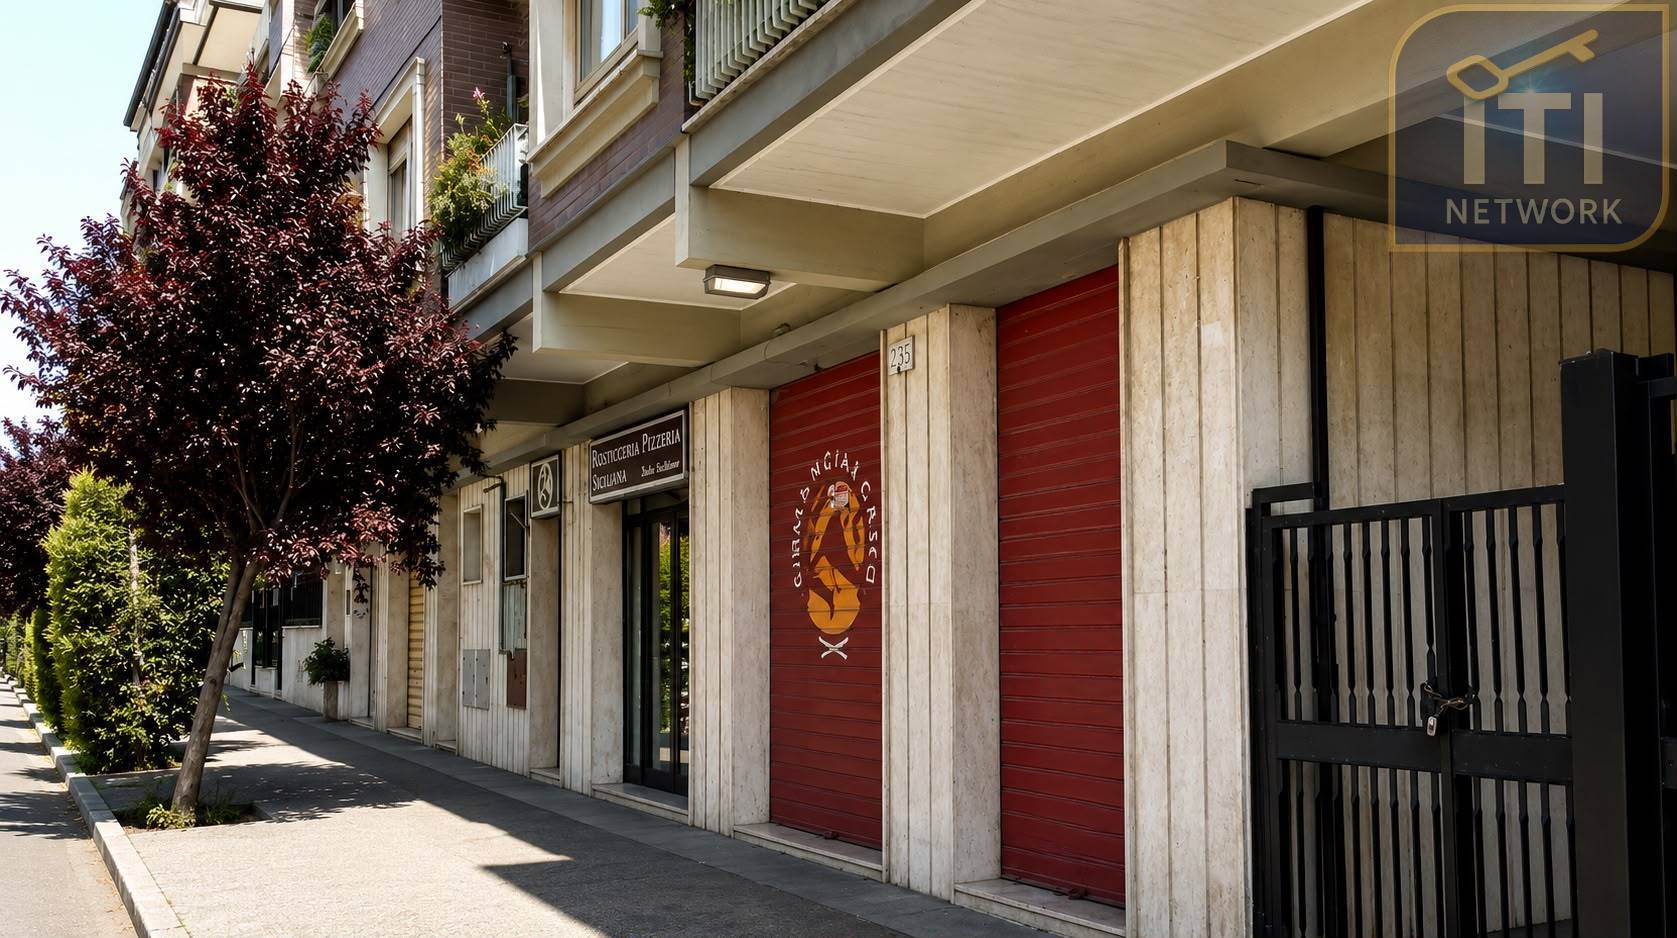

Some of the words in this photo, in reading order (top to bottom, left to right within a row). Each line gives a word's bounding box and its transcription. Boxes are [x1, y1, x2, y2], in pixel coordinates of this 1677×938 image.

[890, 343, 911, 368] 235
[592, 441, 640, 469] ROSTICCERIA
[642, 428, 681, 453] PIZZERIA
